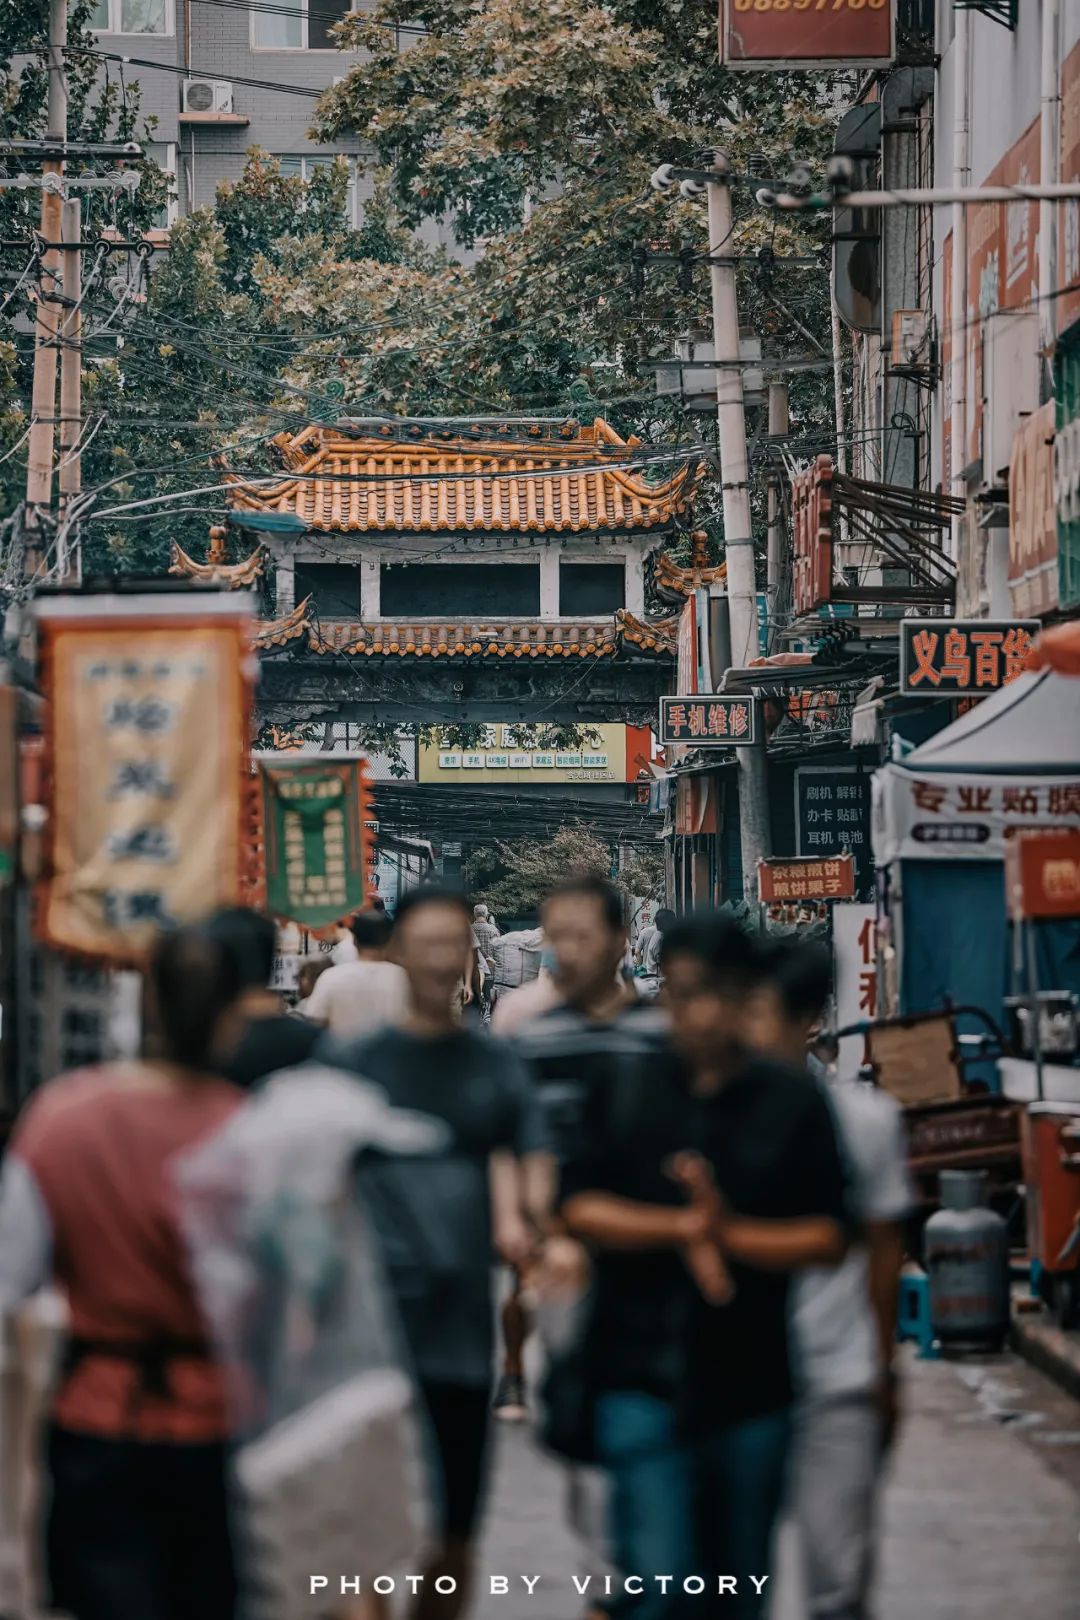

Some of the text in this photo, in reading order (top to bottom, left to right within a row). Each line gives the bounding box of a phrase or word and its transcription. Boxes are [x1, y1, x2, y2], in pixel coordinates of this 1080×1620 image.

[908, 627, 1034, 688] 义乌百货
[667, 703, 749, 737] 手机维修
[806, 786, 833, 800] 刷机
[911, 780, 1080, 815] 专业贴膜
[807, 808, 833, 822] 办卡
[807, 830, 864, 845] 耳机 电池
[772, 861, 840, 880] 杂粮煎饼
[773, 879, 842, 897] 煎饼果子
